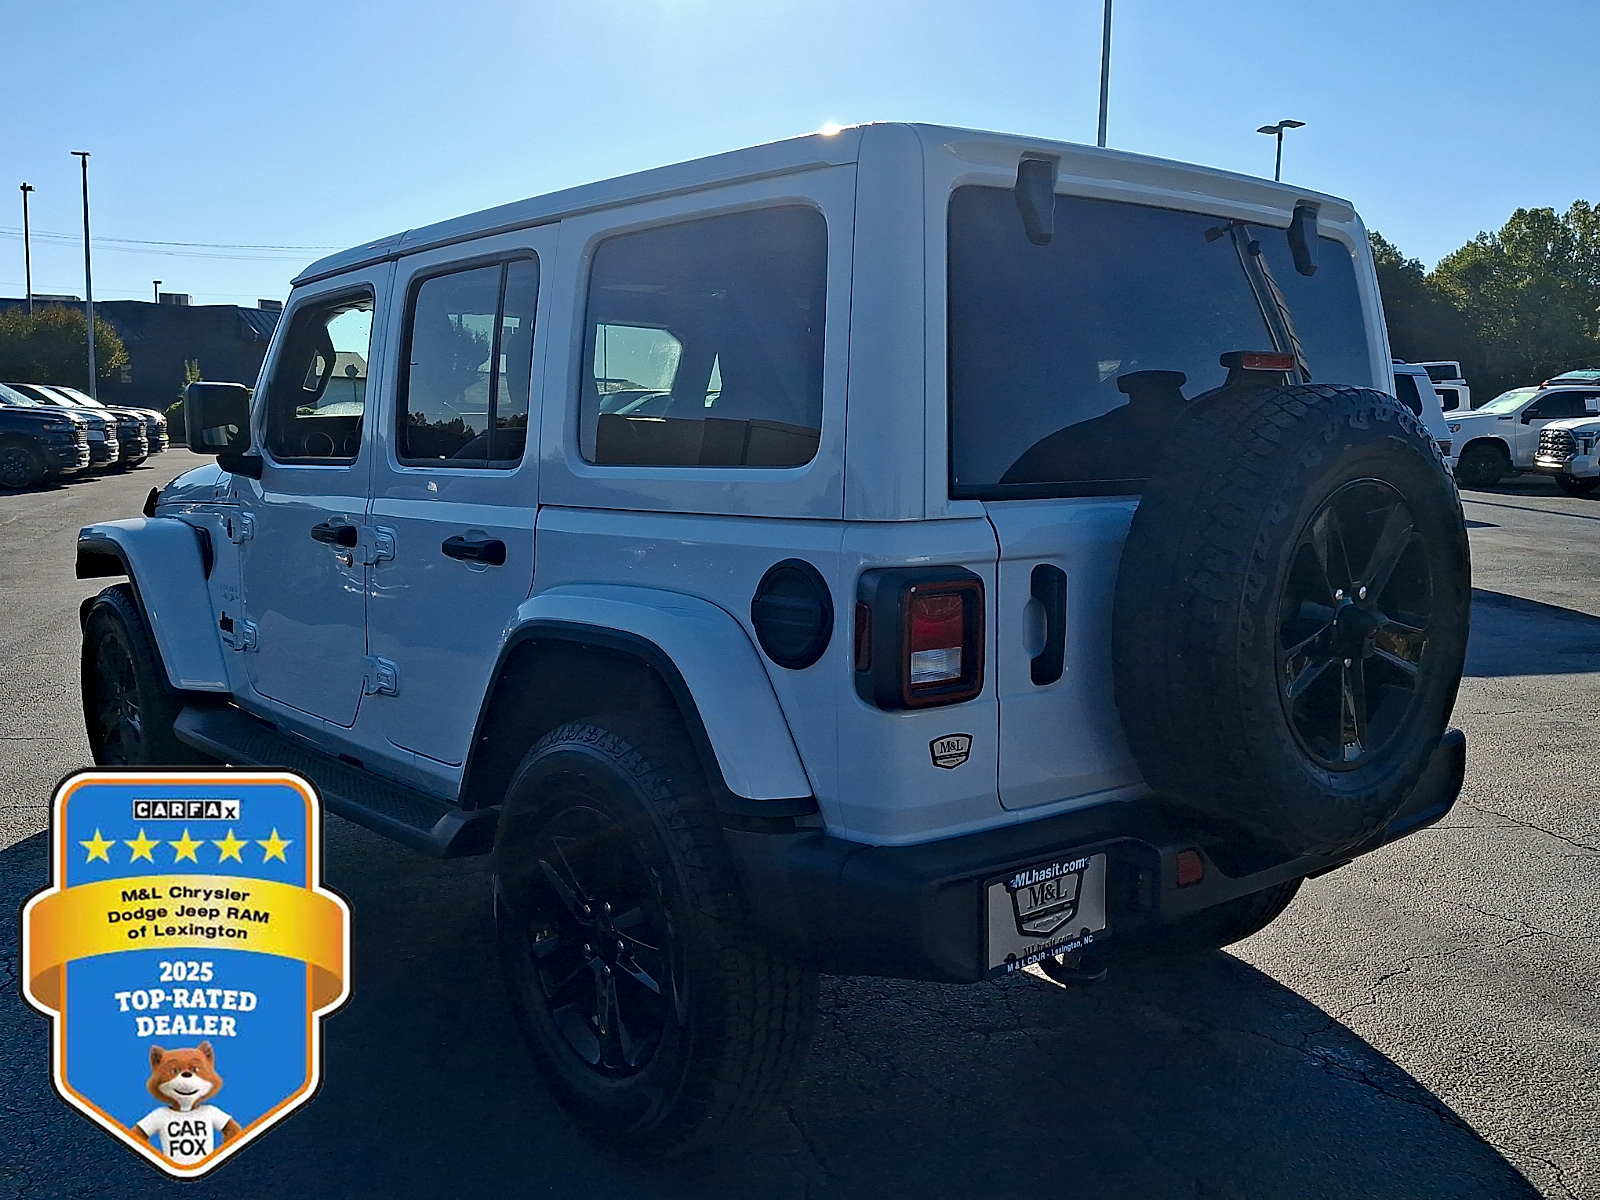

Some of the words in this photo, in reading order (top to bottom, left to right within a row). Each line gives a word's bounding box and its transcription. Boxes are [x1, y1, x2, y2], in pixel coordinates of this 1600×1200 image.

[940, 739, 963, 753] M&L
[1015, 857, 1085, 888] MLhasit.com
[1027, 879, 1068, 909] M&L
[1084, 935, 1094, 945] NC
